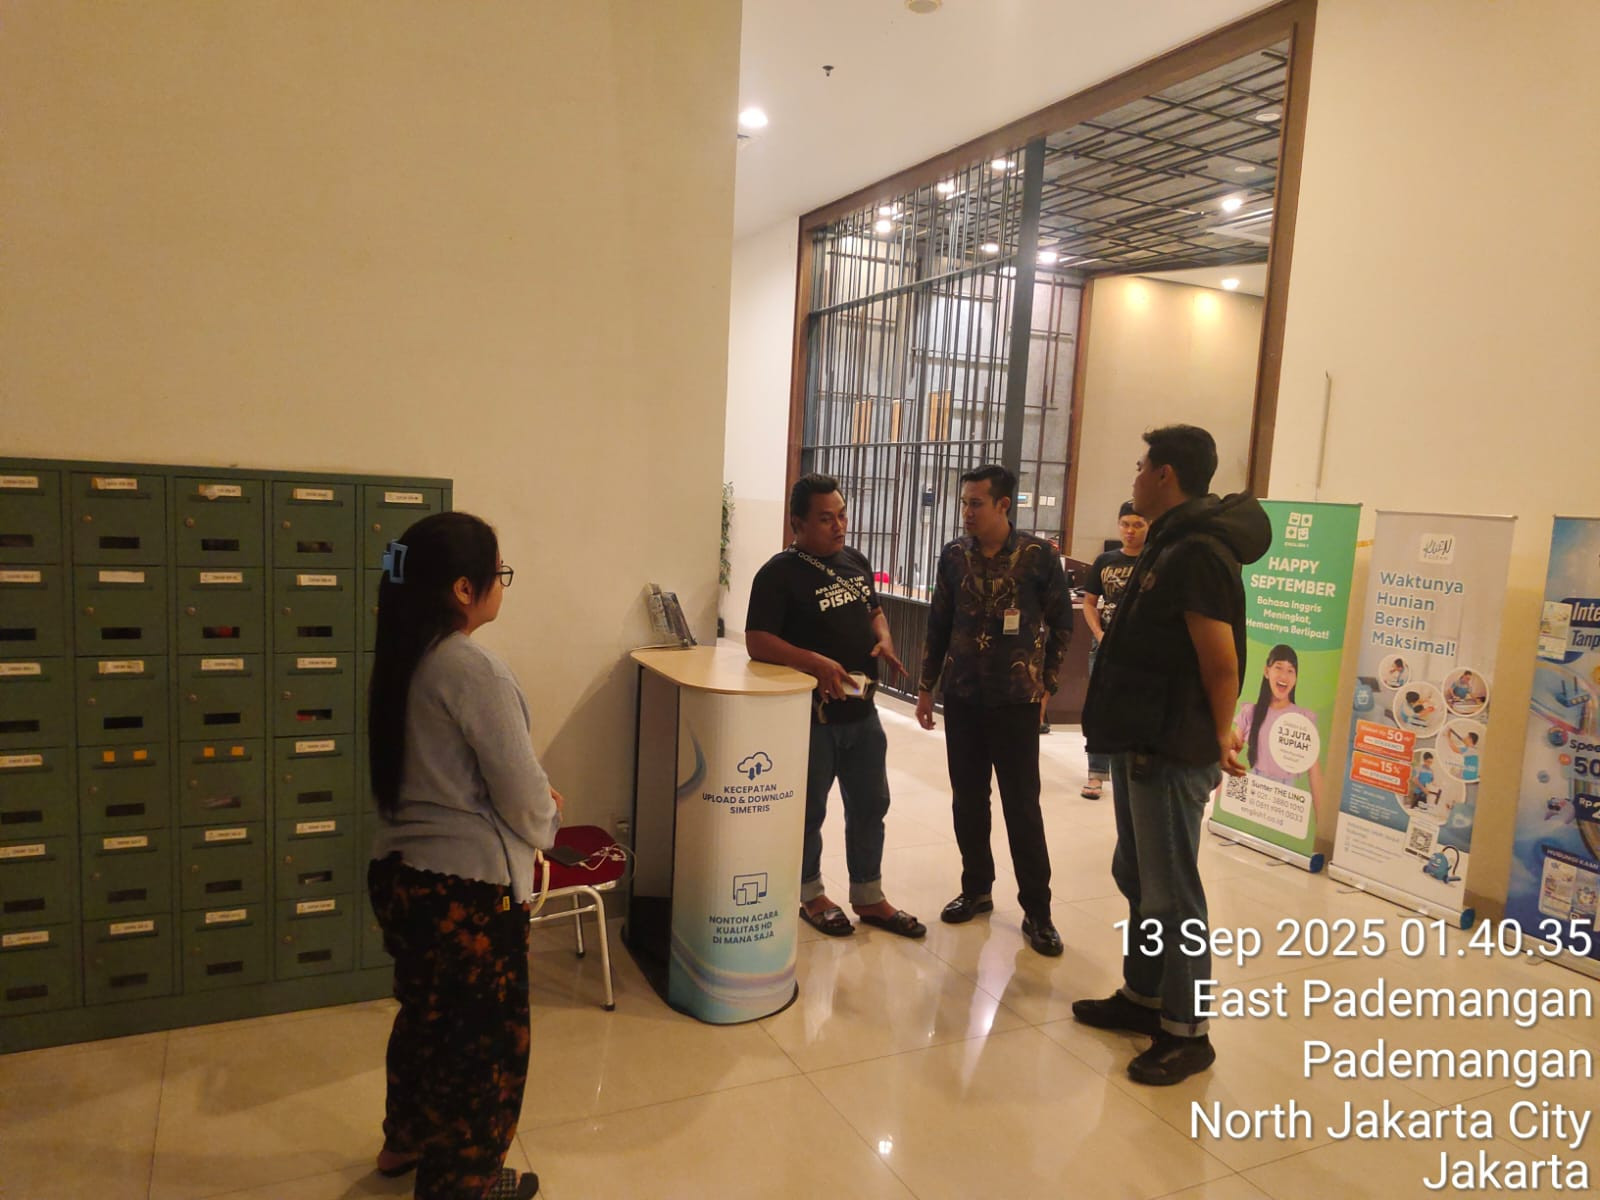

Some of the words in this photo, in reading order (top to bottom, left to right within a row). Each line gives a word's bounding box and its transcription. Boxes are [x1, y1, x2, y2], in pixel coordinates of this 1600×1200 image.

[1268, 556, 1319, 575] HAPPY
[1250, 574, 1336, 597] SEPTEMBER
[1380, 571, 1463, 595] Waktunya
[819, 585, 871, 612] PISAG
[1257, 595, 1290, 608] Bahasa
[1291, 600, 1323, 613] Inggris
[1377, 592, 1434, 611] Hunian
[1263, 608, 1311, 625] Meningkat,
[1375, 611, 1426, 631] Bersih
[1246, 618, 1289, 633] Hematnya
[1290, 624, 1330, 640] Berlipat!
[1371, 630, 1456, 657] Maksimal!
[1291, 730, 1311, 742] JUTA
[1386, 730, 1403, 742] 50
[702, 793, 737, 804] UPLOAD
[738, 796, 746, 804] &
[748, 790, 794, 804] DOWNLOAD
[724, 784, 777, 794] KECEPATAN
[1251, 779, 1273, 792] Sunter
[1274, 786, 1288, 798] THE
[1288, 791, 1306, 803] LINQ
[730, 804, 770, 814] SIMETRIS
[709, 914, 749, 924] NONTON
[751, 909, 778, 923] ACARA
[712, 936, 722, 944] DI
[724, 935, 752, 944] MANA
[754, 930, 774, 941] SAJA
[716, 924, 760, 935] KUALITAS
[761, 921, 772, 931] HD
